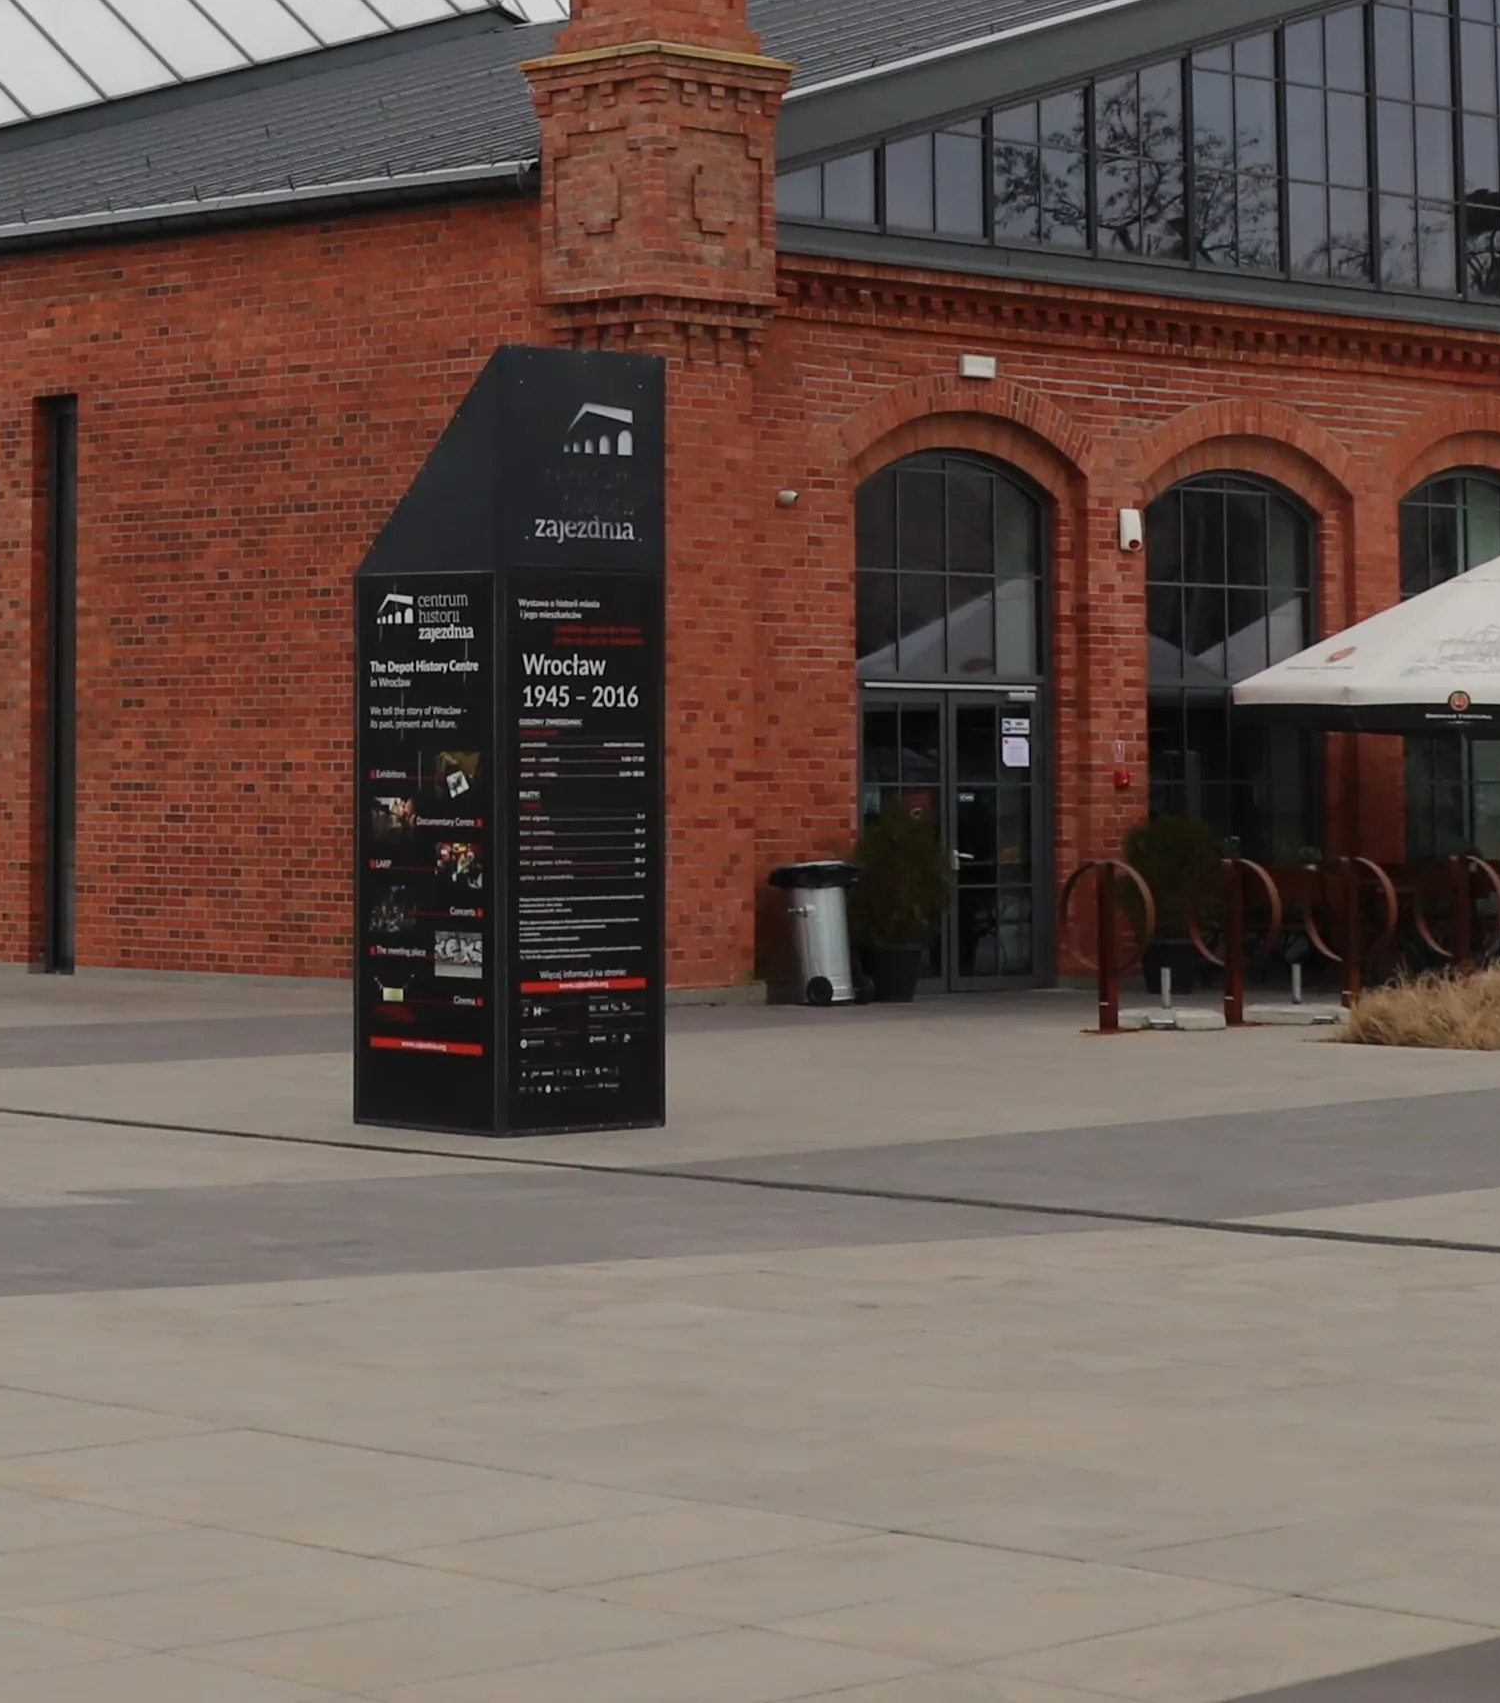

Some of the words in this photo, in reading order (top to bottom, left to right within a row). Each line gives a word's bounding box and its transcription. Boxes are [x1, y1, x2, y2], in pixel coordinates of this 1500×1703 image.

[534, 515, 635, 544] zajezdnia
[417, 594, 468, 607] centrum
[418, 610, 460, 623] historii
[418, 624, 474, 643] zajezdnia
[369, 661, 386, 673] The
[388, 661, 414, 674] Depot
[416, 660, 448, 674] History
[449, 660, 479, 672] Centre
[522, 653, 606, 676] Wrocław
[370, 677, 377, 687] in
[523, 685, 570, 707] 1945
[591, 685, 639, 708] 2016
[369, 706, 381, 715] We
[383, 706, 393, 715] tell
[394, 706, 406, 716] the
[406, 706, 423, 717] story
[424, 706, 432, 715] of
[416, 817, 454, 827] Documentary
[449, 906, 476, 917] Concerts
[376, 945, 388, 954] The
[453, 995, 476, 1006] Cinema
